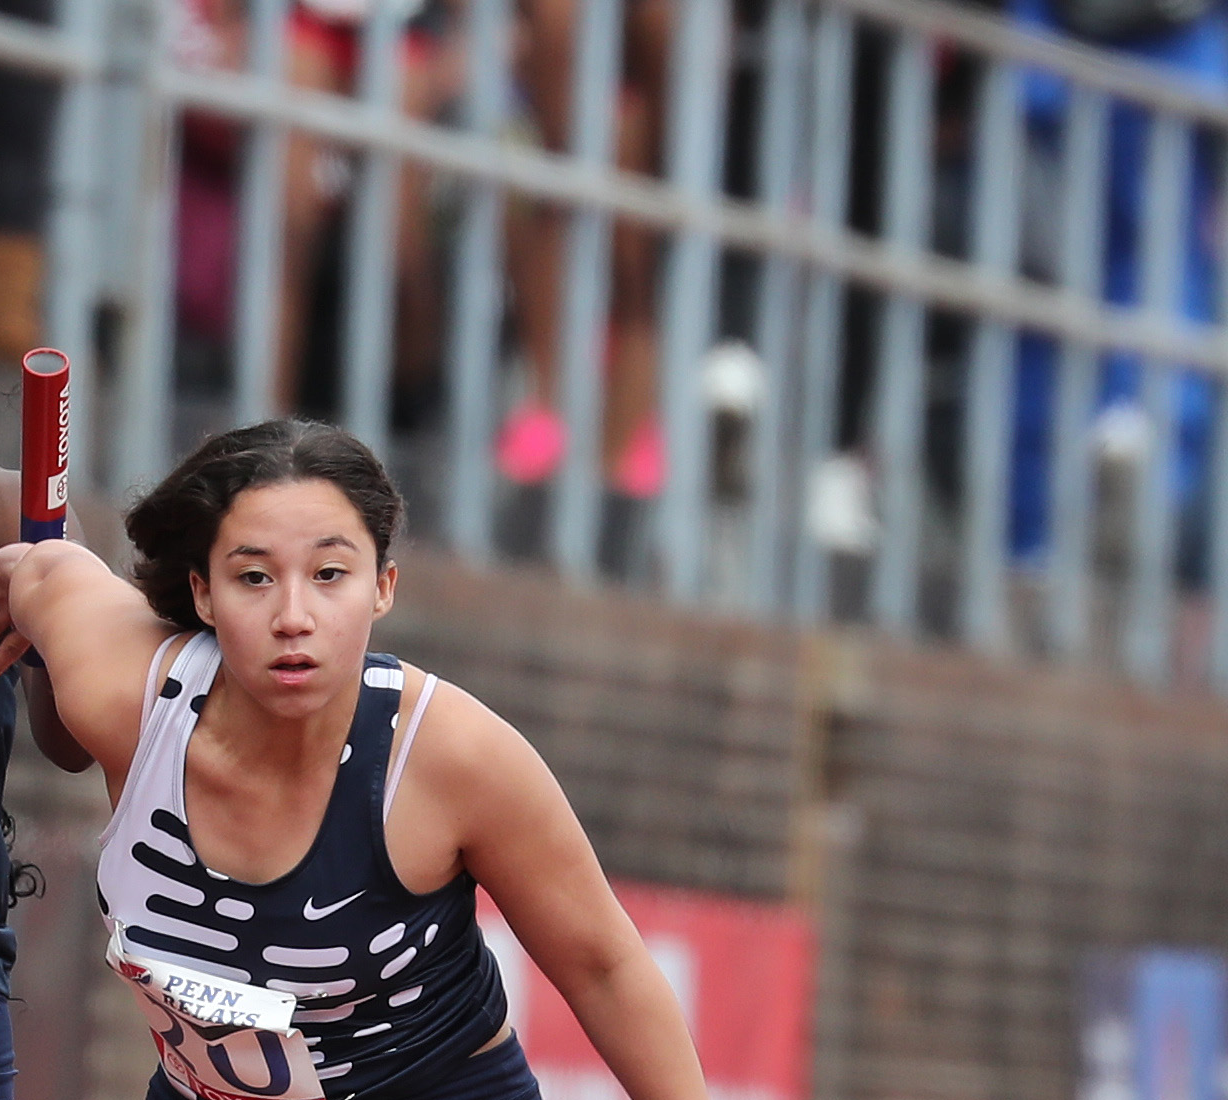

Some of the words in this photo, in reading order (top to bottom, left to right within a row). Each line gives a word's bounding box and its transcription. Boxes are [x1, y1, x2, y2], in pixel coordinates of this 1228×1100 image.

[163, 975, 243, 1007] PENN
[162, 994, 260, 1027] RELAYS
[206, 1030, 292, 1096] U
